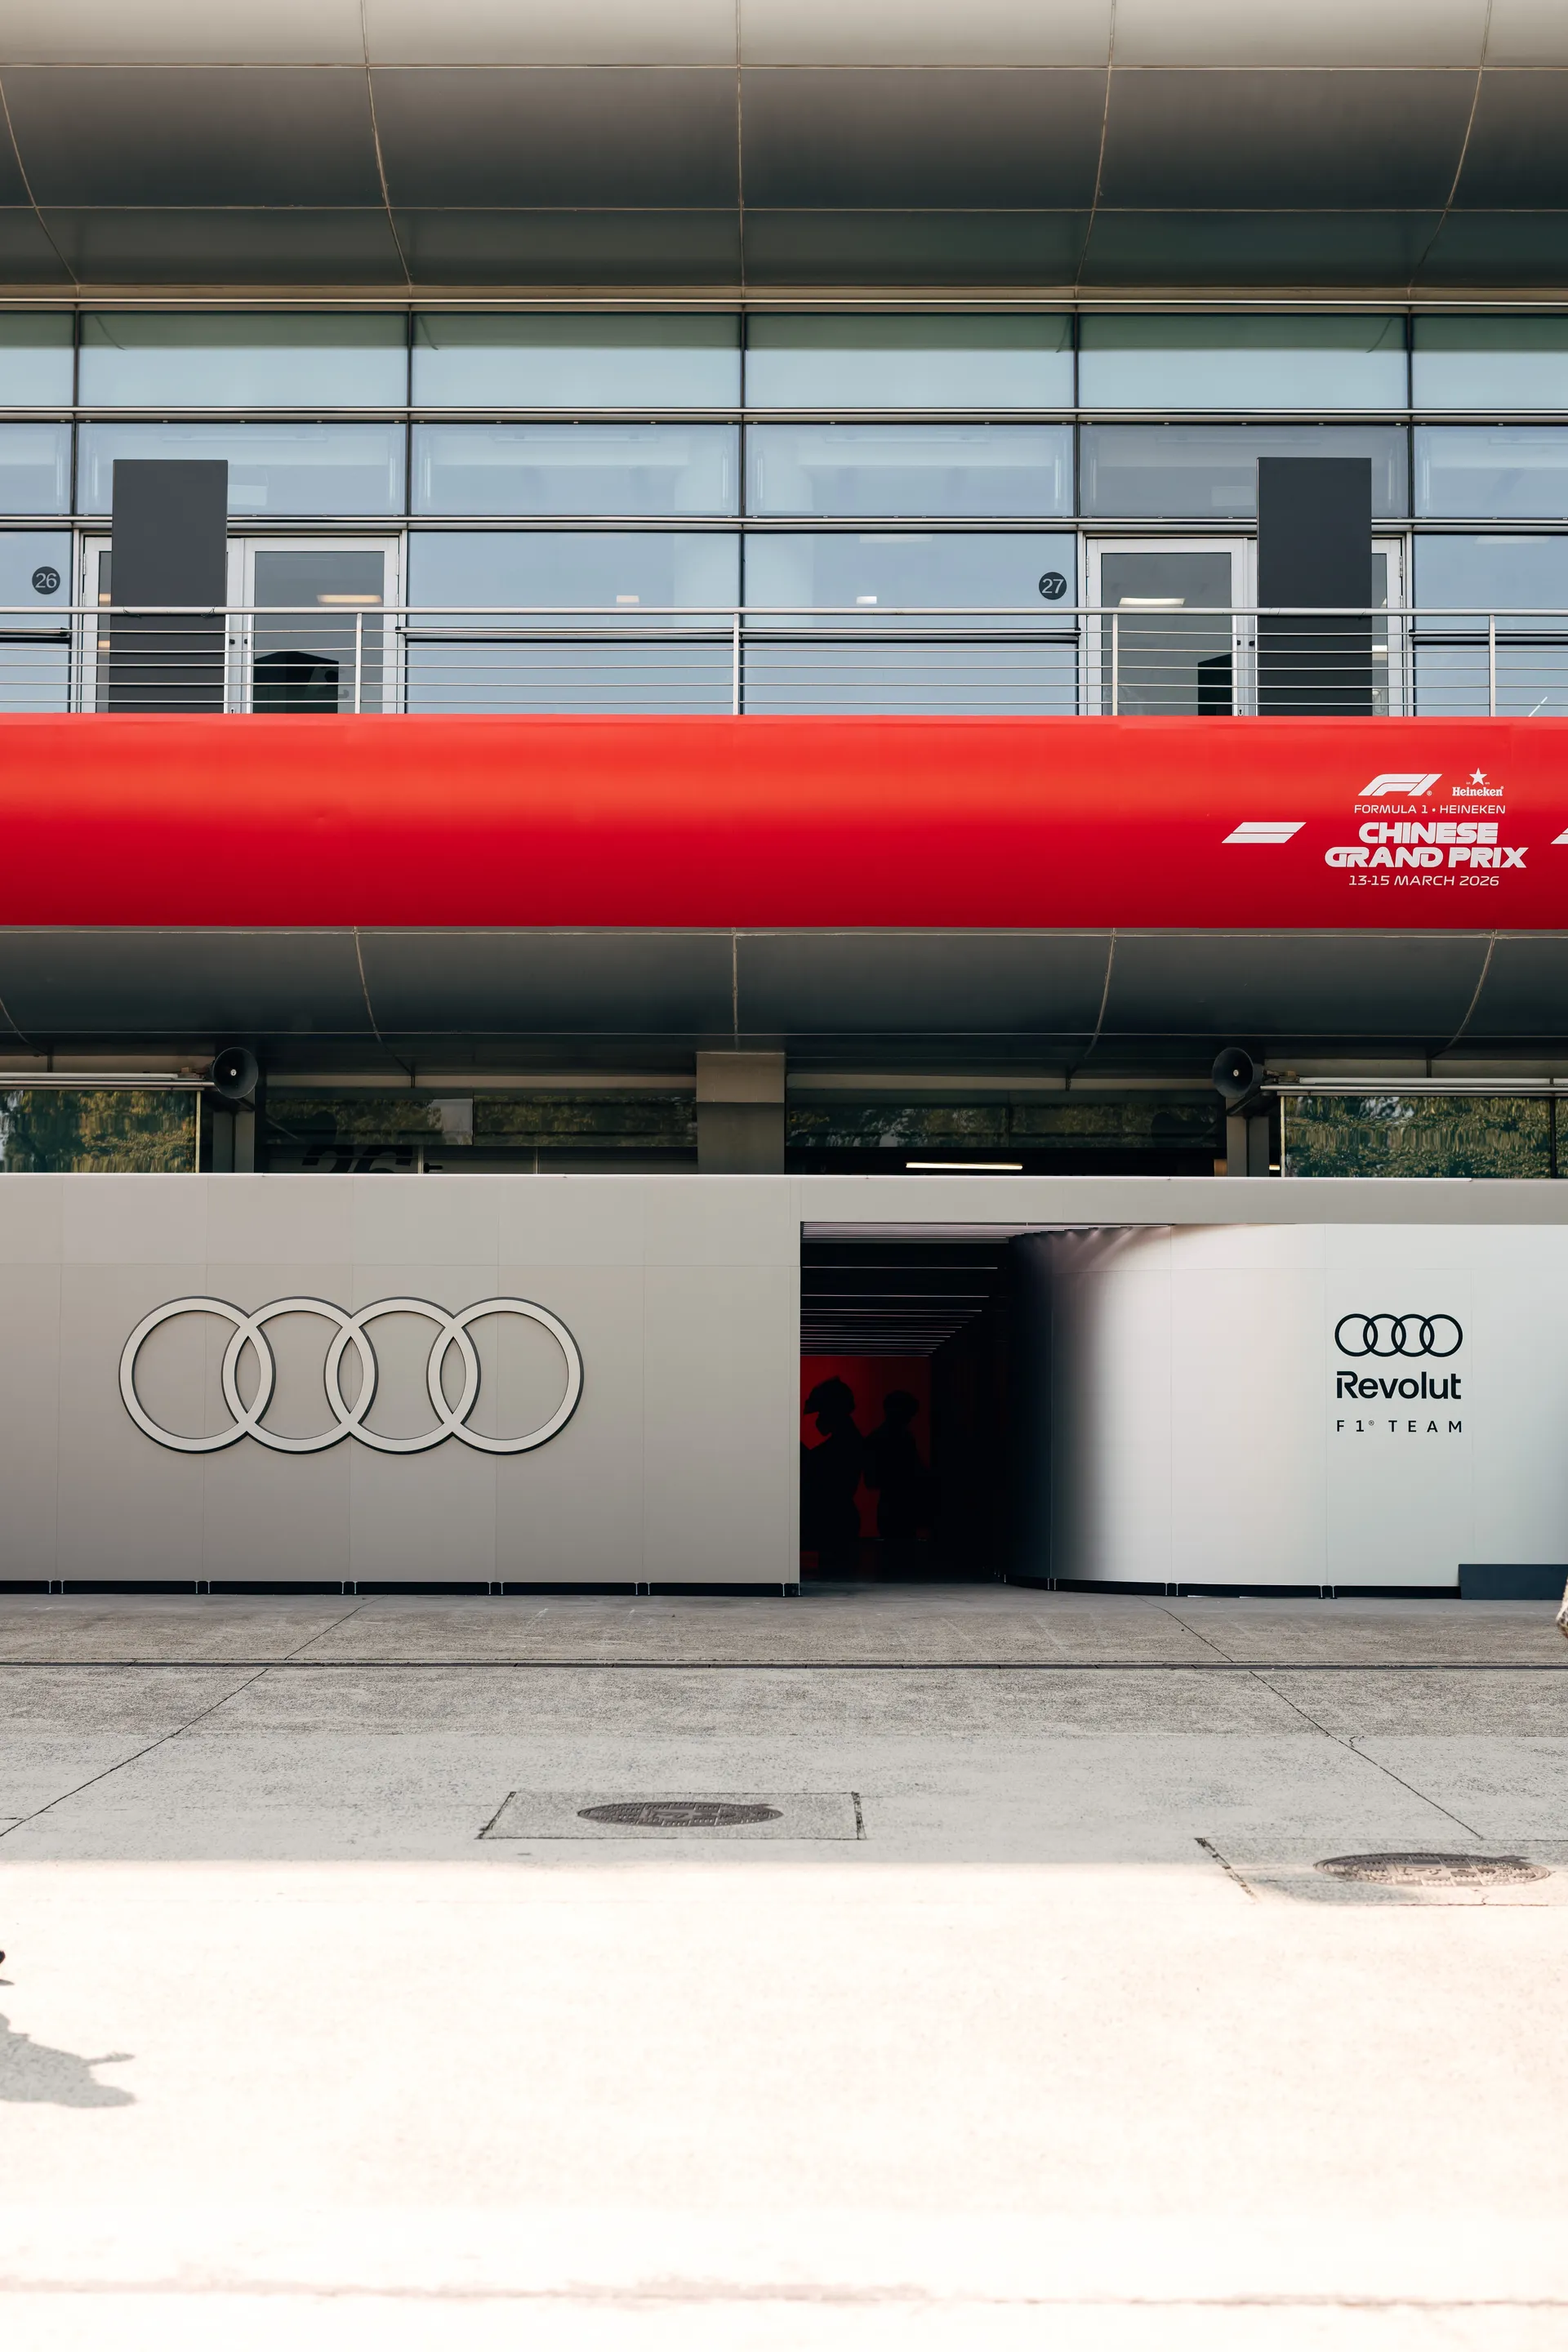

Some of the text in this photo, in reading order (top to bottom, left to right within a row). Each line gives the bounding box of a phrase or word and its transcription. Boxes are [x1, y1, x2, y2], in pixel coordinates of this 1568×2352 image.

[35, 572, 57, 588] 26
[1041, 578, 1064, 594] 27
[1354, 804, 1506, 814] FORMULA 1 HEINEKEN
[1358, 822, 1499, 844] CHINESE
[1325, 846, 1529, 869] GRAND PRIX
[1348, 875, 1499, 887] 13-15 MARCH 2026
[1336, 1370, 1462, 1400] Revolut
[1388, 1419, 1462, 1433] TEAM
